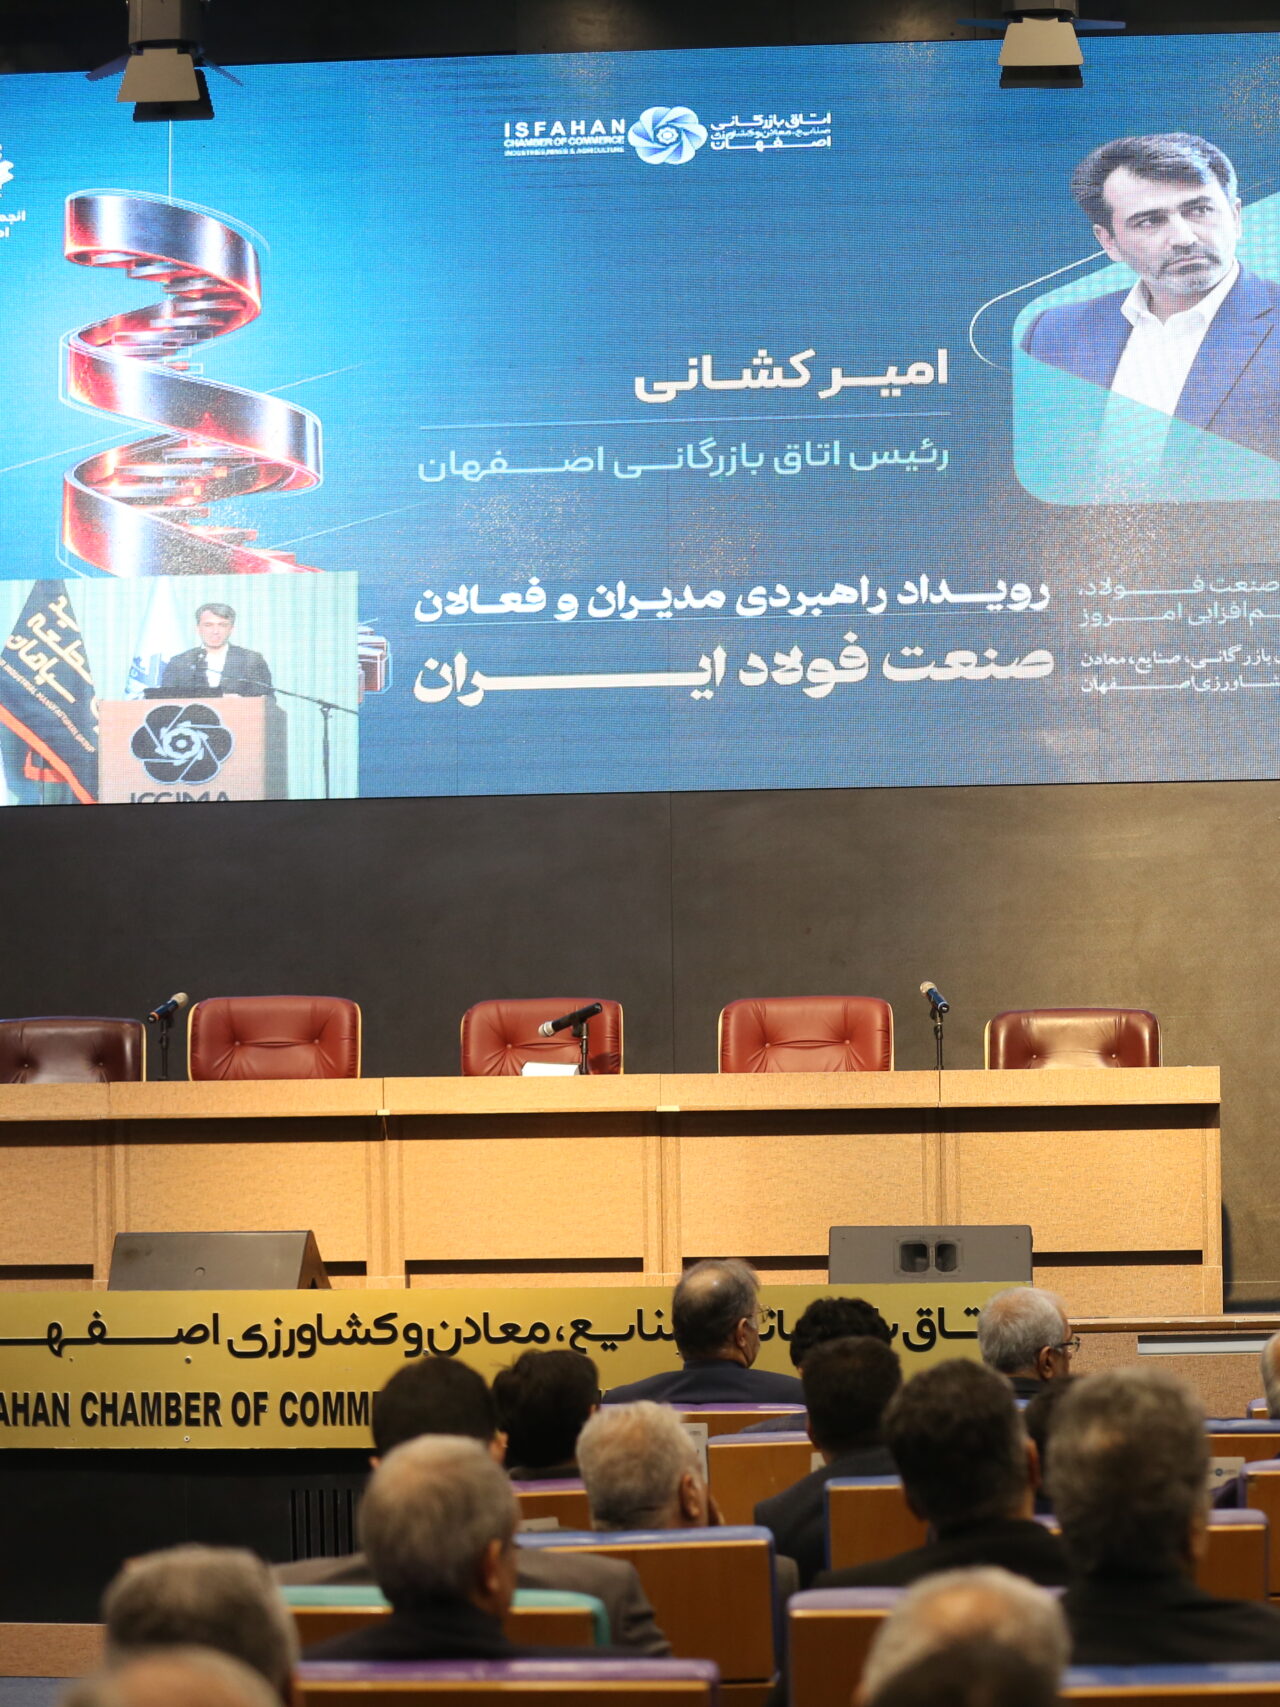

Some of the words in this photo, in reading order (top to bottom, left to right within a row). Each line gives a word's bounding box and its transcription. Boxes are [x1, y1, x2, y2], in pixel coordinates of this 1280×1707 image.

[504, 118, 626, 138] ISFAHAN
[710, 113, 785, 131] بازرگانی
[784, 111, 832, 129] اتاق
[503, 137, 553, 148] CHAMBER
[555, 137, 567, 147] OF
[710, 135, 832, 152] اصفهان
[633, 348, 816, 403] کشانی
[817, 348, 949, 400] امیر
[417, 446, 605, 483] اصفهان
[613, 437, 765, 480] بازرگانی
[773, 440, 841, 475] اتاق
[848, 436, 950, 473] رئیس
[414, 577, 547, 622] فعالان
[587, 580, 726, 620] مدیران
[735, 575, 888, 618] راهبردی
[895, 573, 1052, 612] رویداد
[1210, 577, 1279, 593] صنعت
[553, 594, 580, 622] و
[1079, 601, 1183, 628] امروز
[413, 645, 728, 707] ایران
[739, 631, 870, 699] فولاد
[881, 643, 1056, 683] صنعت
[1081, 652, 1126, 667] معادن
[1081, 674, 1195, 695] اصفهان
[0, 1308, 221, 1358] اصفه
[227, 1311, 399, 1359] کشاورزی
[402, 1321, 424, 1358] و
[427, 1311, 551, 1358] معادن
[555, 1308, 674, 1355] نایع،
[902, 1306, 981, 1353] تاق
[80, 1391, 224, 1428] CHAMBER
[231, 1391, 270, 1428] OF
[279, 1390, 376, 1428] COMM
